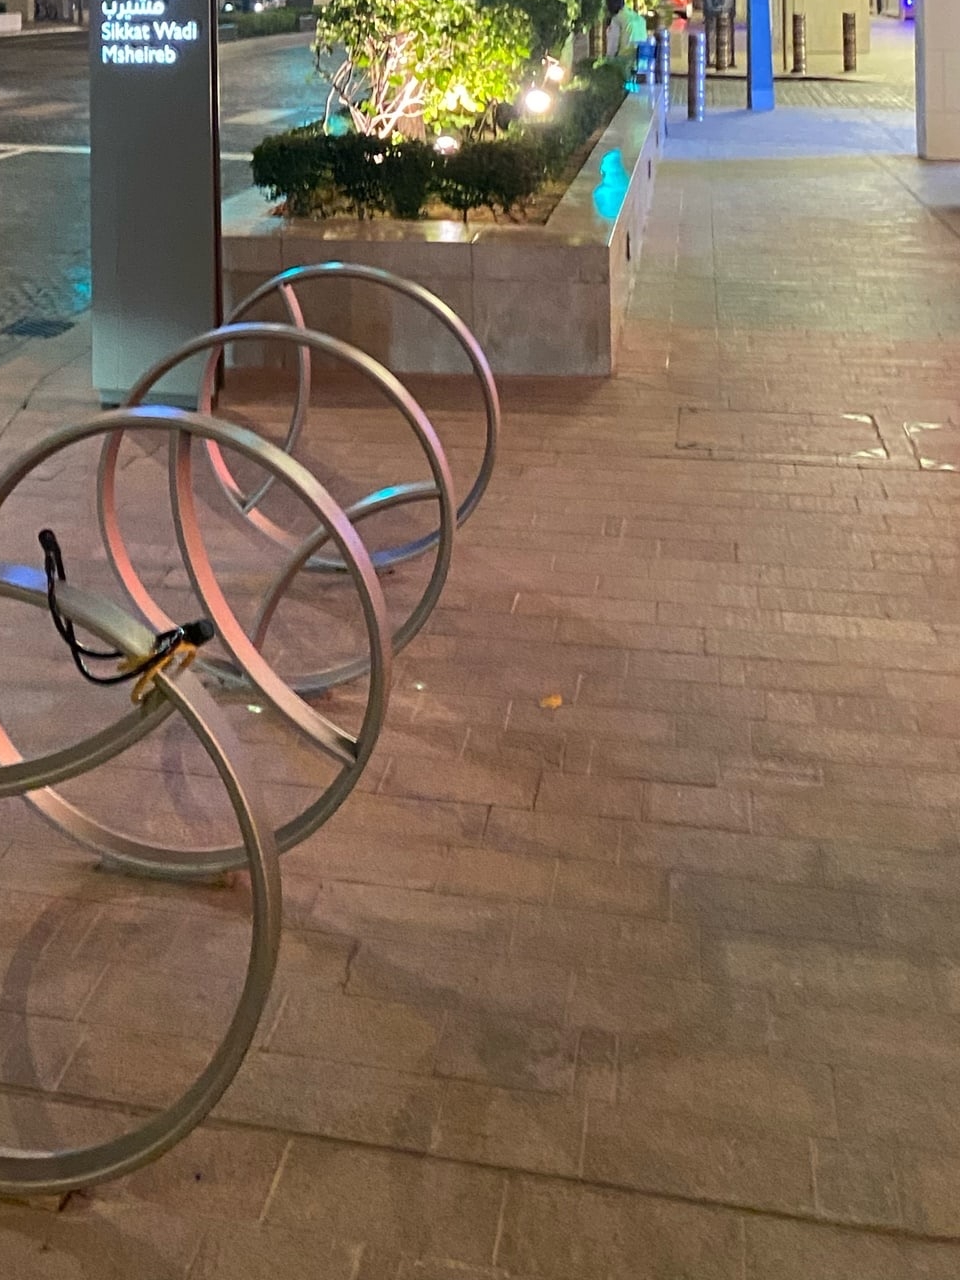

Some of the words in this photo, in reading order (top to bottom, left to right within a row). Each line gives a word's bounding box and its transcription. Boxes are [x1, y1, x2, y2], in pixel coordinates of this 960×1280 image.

[101, 21, 151, 41] Sikkat
[152, 21, 198, 41] Wadi
[102, 44, 177, 64] Msheireb
